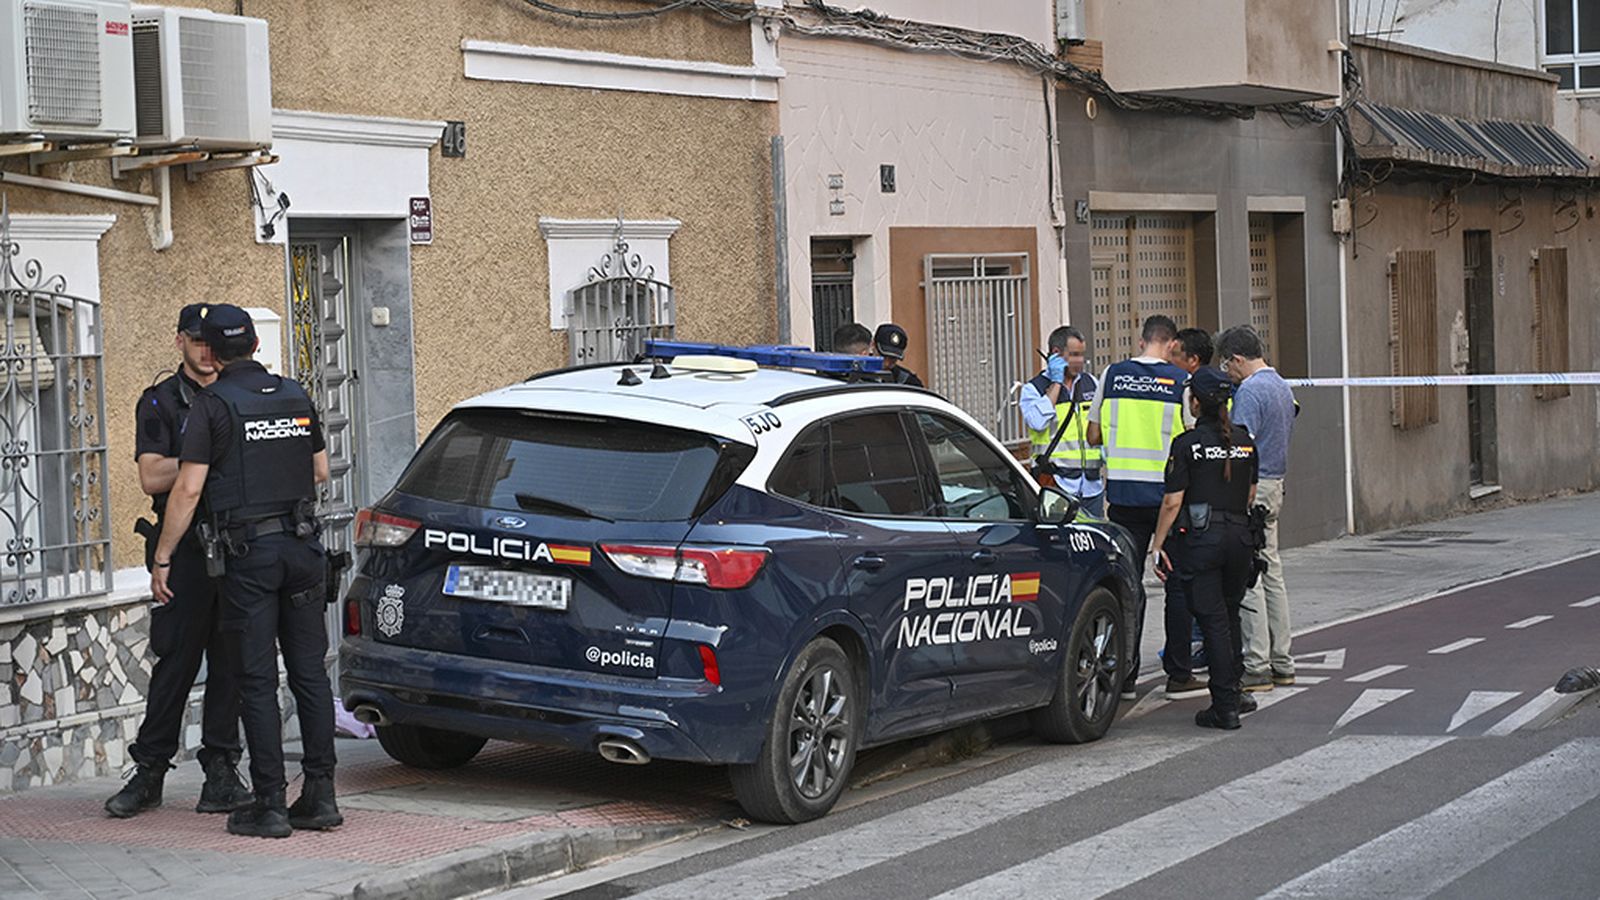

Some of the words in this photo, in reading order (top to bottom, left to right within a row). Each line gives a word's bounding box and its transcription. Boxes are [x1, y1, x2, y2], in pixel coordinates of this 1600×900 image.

[1112, 383, 1174, 395] NACIONAL
[246, 427, 311, 441] NACIONAL
[897, 607, 1031, 649] NACIONAL
[585, 646, 654, 669] @policia
